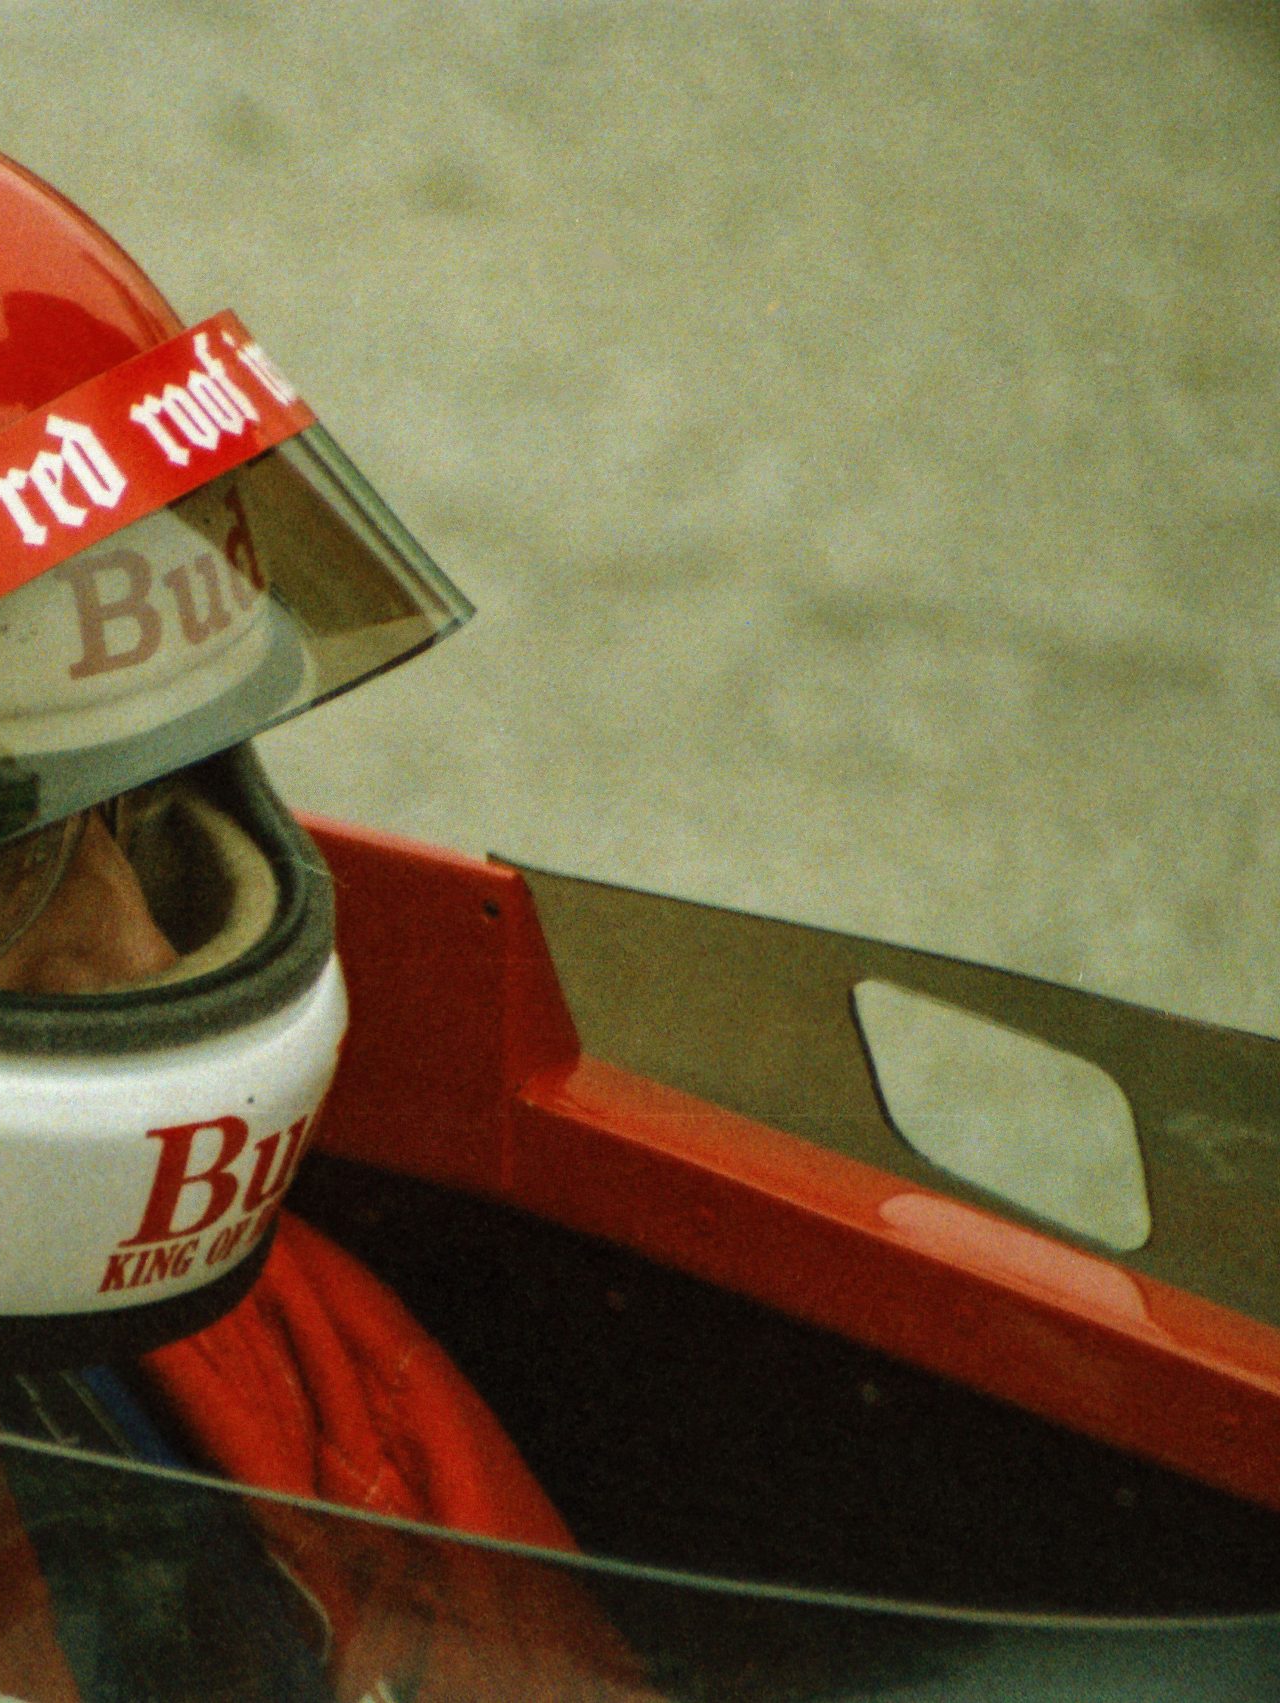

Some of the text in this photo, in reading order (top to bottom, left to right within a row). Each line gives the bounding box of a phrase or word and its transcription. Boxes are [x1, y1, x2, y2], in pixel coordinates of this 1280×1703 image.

[129, 331, 260, 467] roof
[55, 484, 266, 681] Bud
[118, 1114, 308, 1248] Bu
[97, 1238, 200, 1294] KING
[205, 1216, 253, 1267] OF
